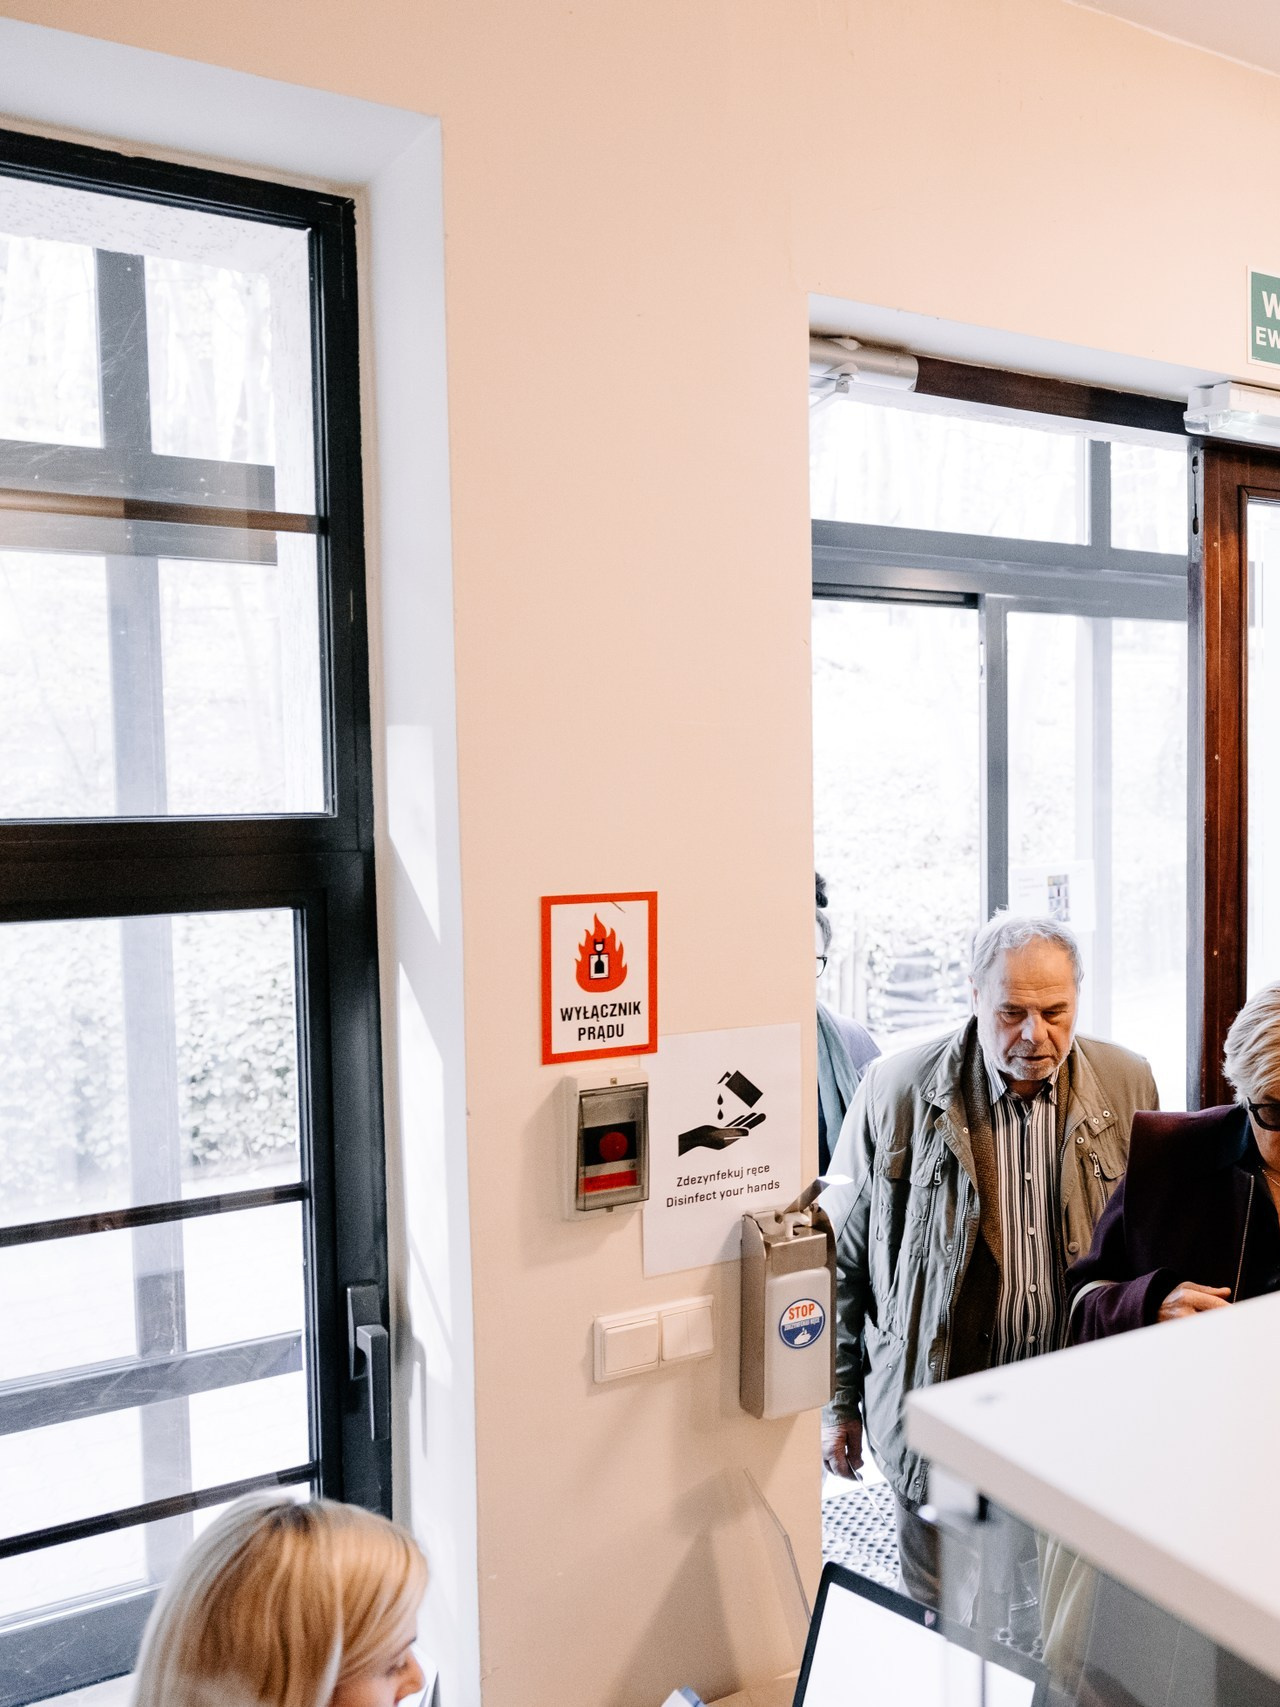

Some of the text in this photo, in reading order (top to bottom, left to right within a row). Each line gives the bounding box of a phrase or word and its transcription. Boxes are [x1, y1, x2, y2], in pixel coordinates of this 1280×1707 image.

[560, 1001, 642, 1022] WYŁĄCZNIK
[577, 1023, 625, 1042] PRĄDU
[676, 1164, 770, 1187] Zdezynfekuj ręce
[666, 1179, 780, 1208] Disinfect your hands
[788, 1303, 815, 1320] STOP
